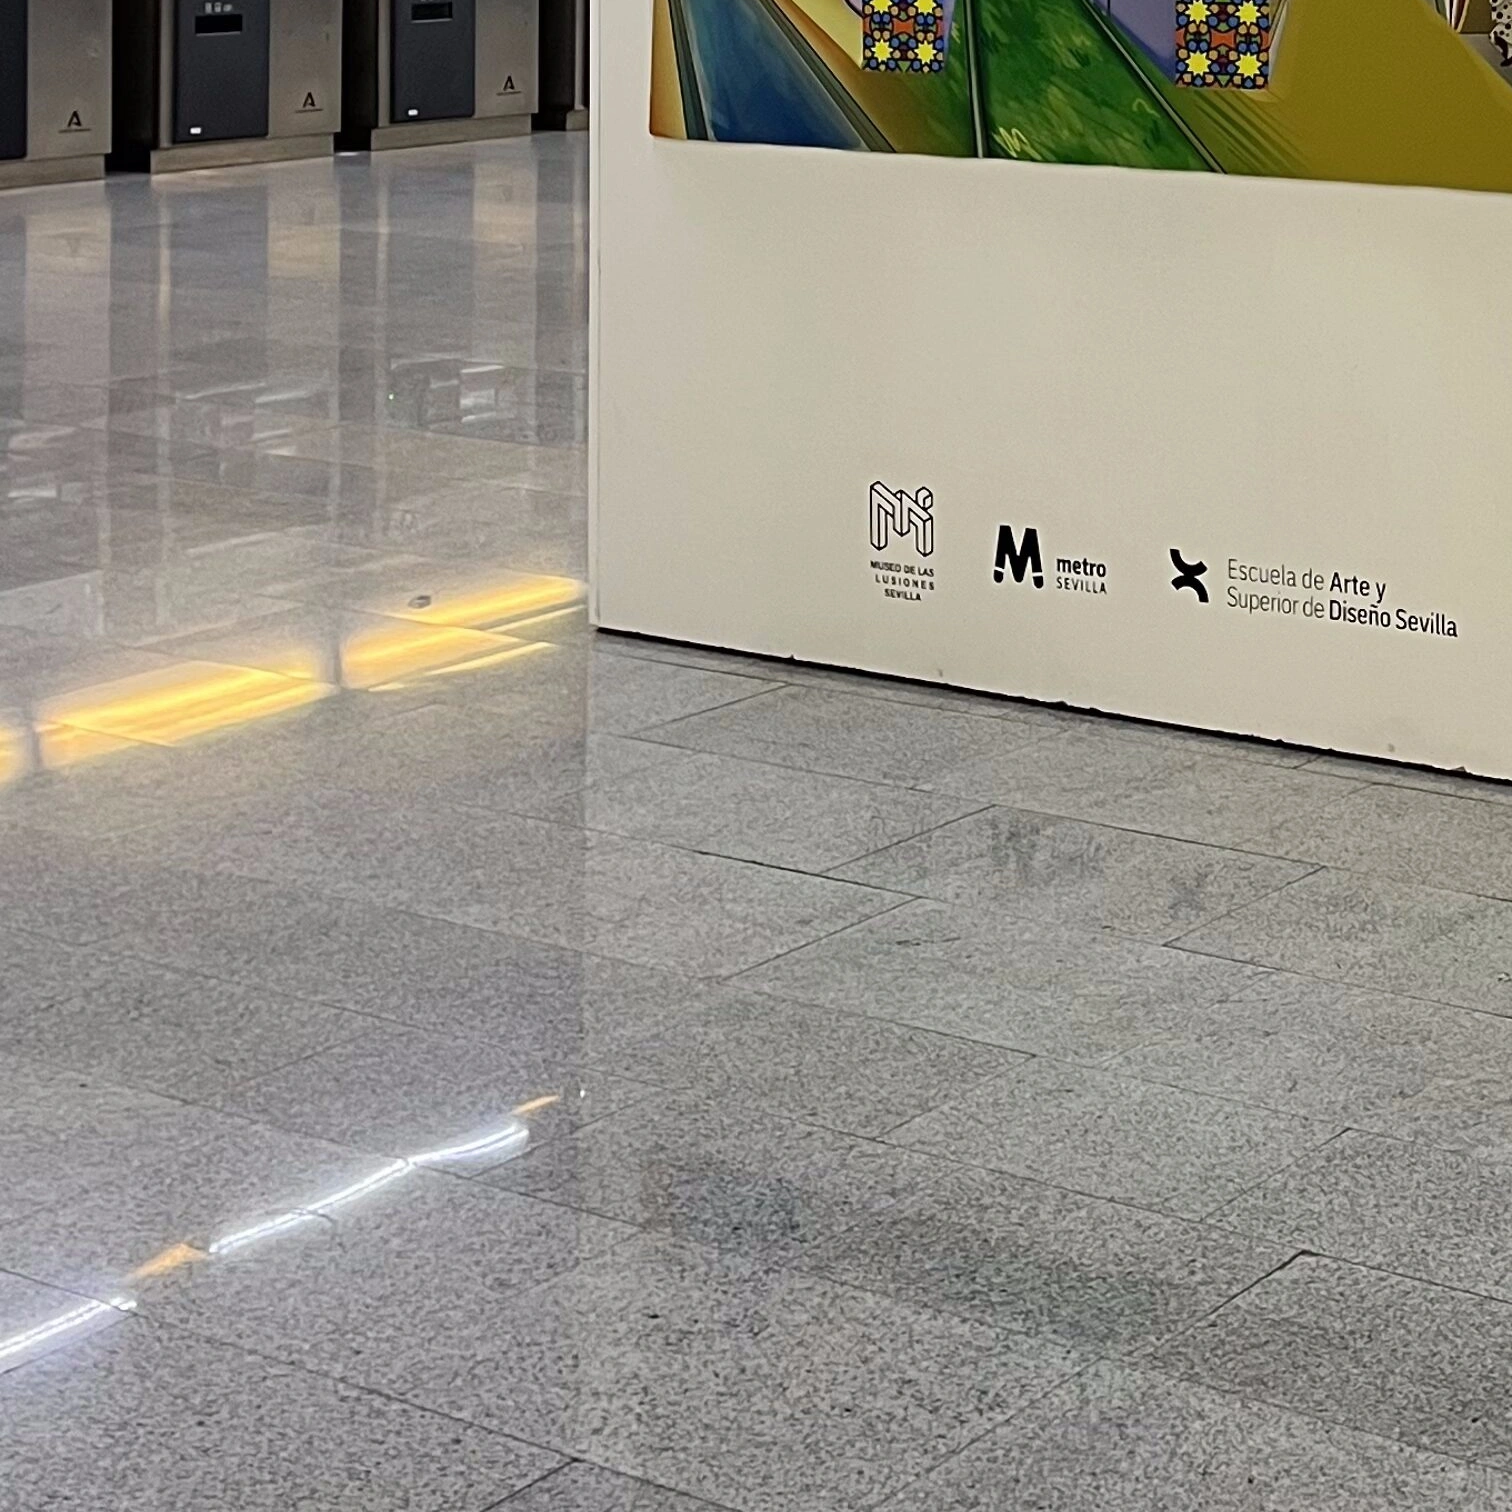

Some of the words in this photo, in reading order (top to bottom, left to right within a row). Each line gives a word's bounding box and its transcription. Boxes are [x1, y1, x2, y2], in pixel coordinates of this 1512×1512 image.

[870, 560, 901, 574] MUSEO
[903, 564, 916, 575] DE
[918, 566, 934, 577] LAS
[1056, 557, 1107, 578] metro
[1056, 576, 1108, 595] SEVILLA
[1228, 558, 1297, 587] Escuela
[1302, 568, 1325, 591] de
[1329, 571, 1371, 597] Arte
[1375, 581, 1387, 603] y
[884, 588, 922, 601] SEVILLA
[1227, 586, 1300, 615] Superior
[1302, 596, 1325, 619] de
[1328, 599, 1391, 628] Diseño
[1395, 608, 1459, 638] Sevilla
